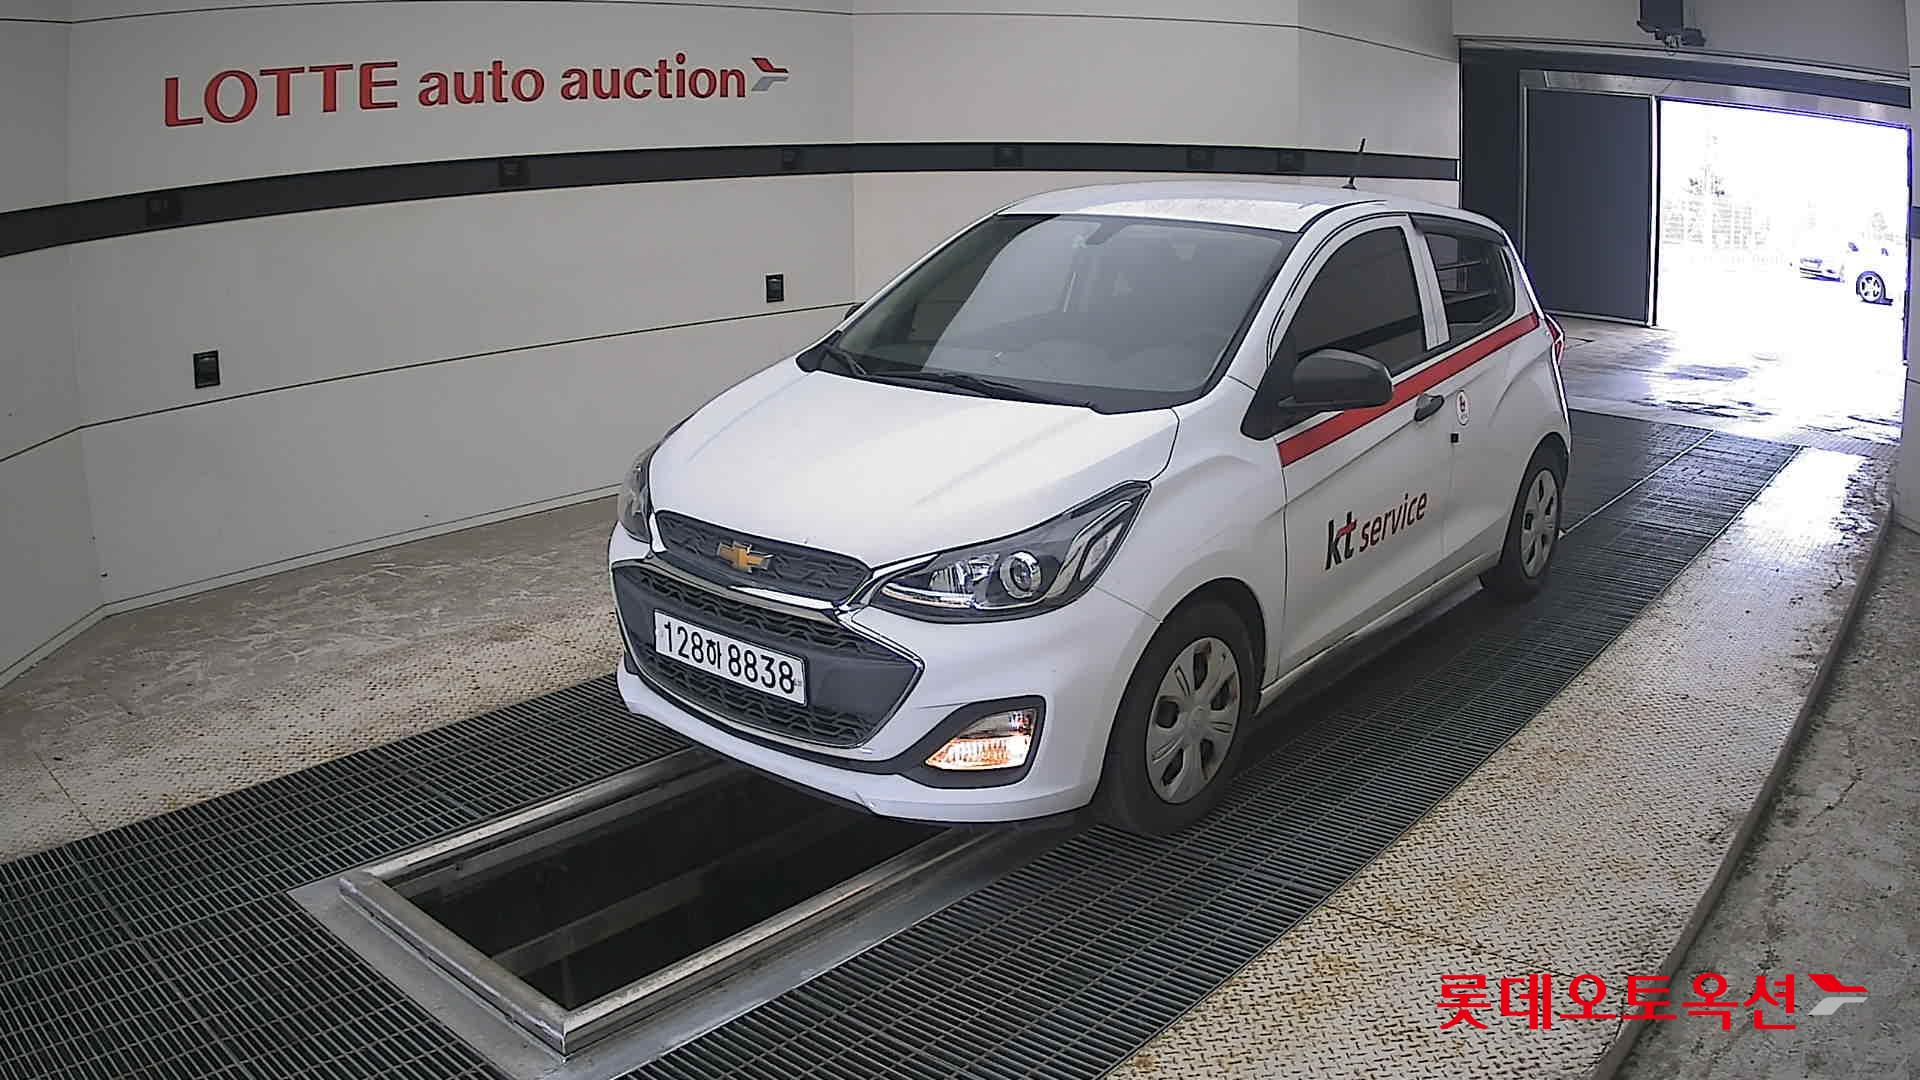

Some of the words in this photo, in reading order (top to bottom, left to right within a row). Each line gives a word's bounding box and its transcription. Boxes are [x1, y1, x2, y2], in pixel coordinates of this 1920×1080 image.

[163, 61, 399, 127] LOTTE
[418, 60, 545, 107] auto
[560, 53, 747, 100] auction
[1325, 511, 1357, 571] kt
[1359, 492, 1428, 552] service
